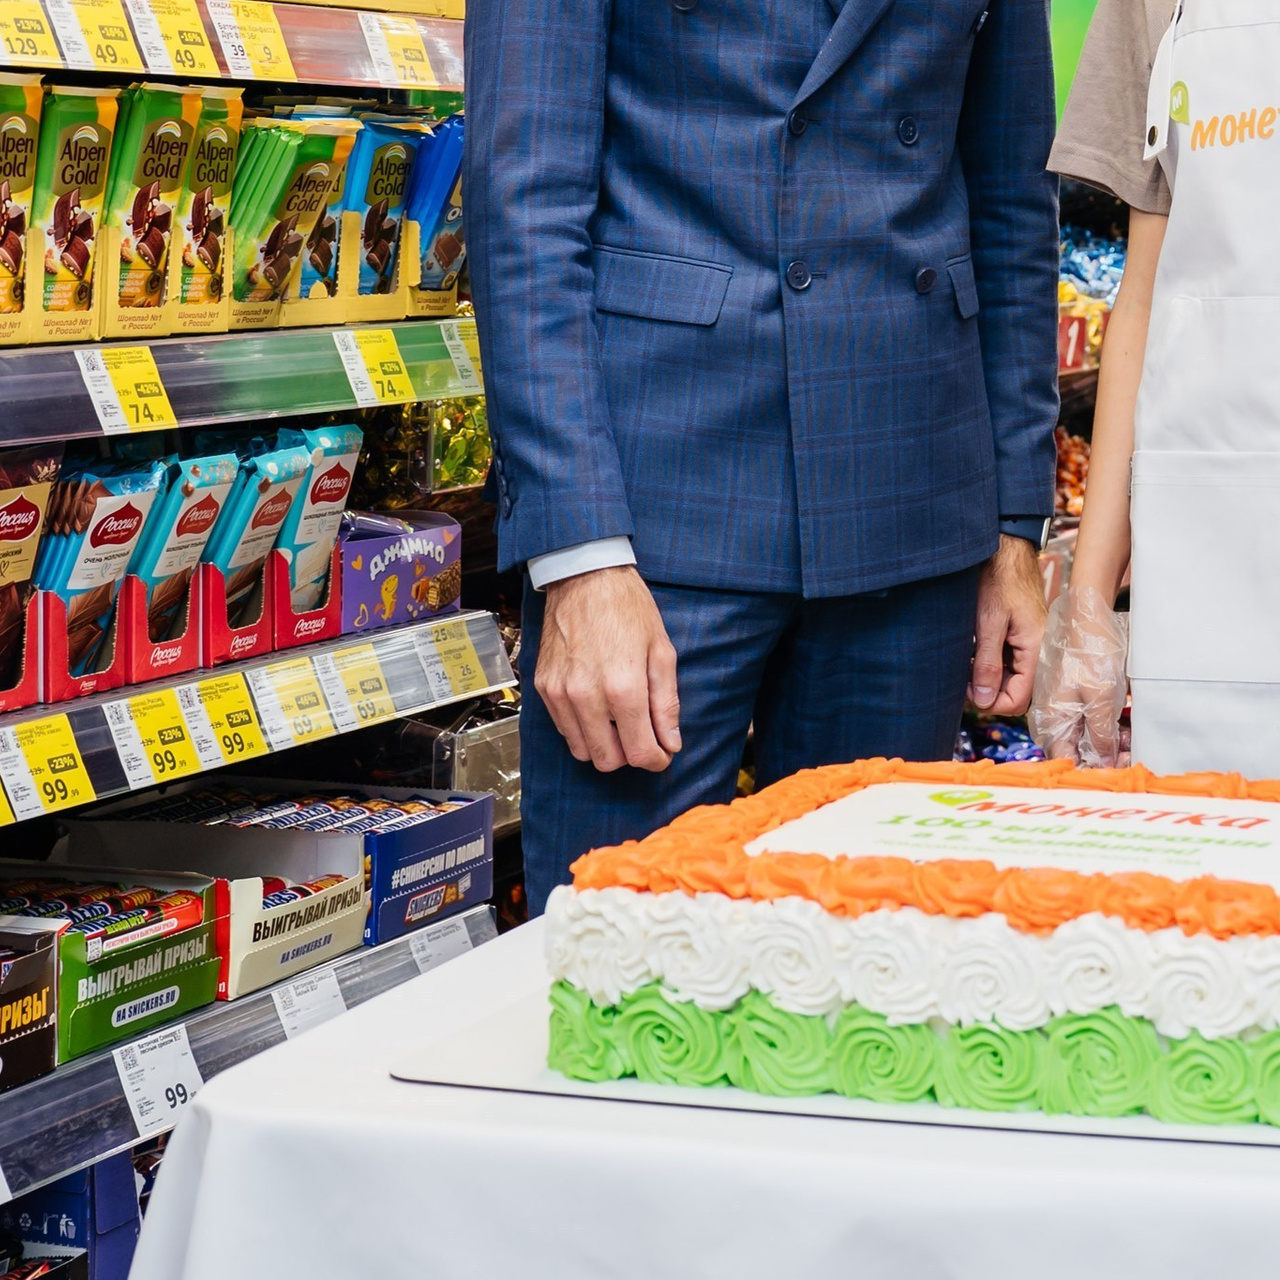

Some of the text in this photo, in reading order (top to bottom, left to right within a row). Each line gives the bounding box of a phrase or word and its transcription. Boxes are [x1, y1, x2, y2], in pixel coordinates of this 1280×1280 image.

[5, 36, 38, 56] 129
[95, 43, 118, 64] 49
[231, 44, 245, 57] 39
[175, 48, 196, 69] 49
[0, 134, 34, 155] lpen
[60, 139, 107, 164] Alpen
[143, 134, 189, 159] Alpen
[195, 140, 234, 163] Alpen
[61, 163, 99, 186] Gold
[142, 157, 180, 180] Gold
[196, 163, 228, 184] Gold
[373, 157, 412, 178] Alpen
[290, 174, 334, 194] Alpen
[373, 177, 406, 197] Gold
[286, 193, 324, 213] Gold
[43, 318, 78, 328] Шоколад
[117, 314, 150, 323] Шоколад
[178, 311, 208, 320] Шоколад
[232, 308, 262, 317] Шоколад
[375, 379, 397, 398] 74
[128, 402, 155, 424] 74
[314, 475, 349, 495] Россия
[98, 514, 139, 537] Россия
[184, 506, 217, 526] Россия
[83, 555, 103, 565] ОЧЕНЬ
[293, 615, 327, 636] Россия
[230, 632, 258, 652] Россия
[150, 644, 183, 663] Россия
[228, 712, 250, 725] -23%
[356, 698, 377, 719] 69
[159, 728, 183, 742] -23%
[293, 714, 314, 736] 69
[222, 732, 246, 756] 99
[49, 755, 75, 770] -23%
[152, 749, 177, 774] 99
[42, 777, 69, 804] 99
[252, 896, 328, 943] ВЫИГРЫВАЙ
[328, 882, 365, 918] ПРИЗЫ
[407, 888, 444, 917] SNICKERS
[290, 933, 333, 960] SNICKERS.RU
[77, 933, 209, 1003] ВЫИГРЫВАЙ ПРИЗЫ
[115, 988, 177, 1024] НА SNICKERS.RU
[164, 1082, 188, 1109] 99
